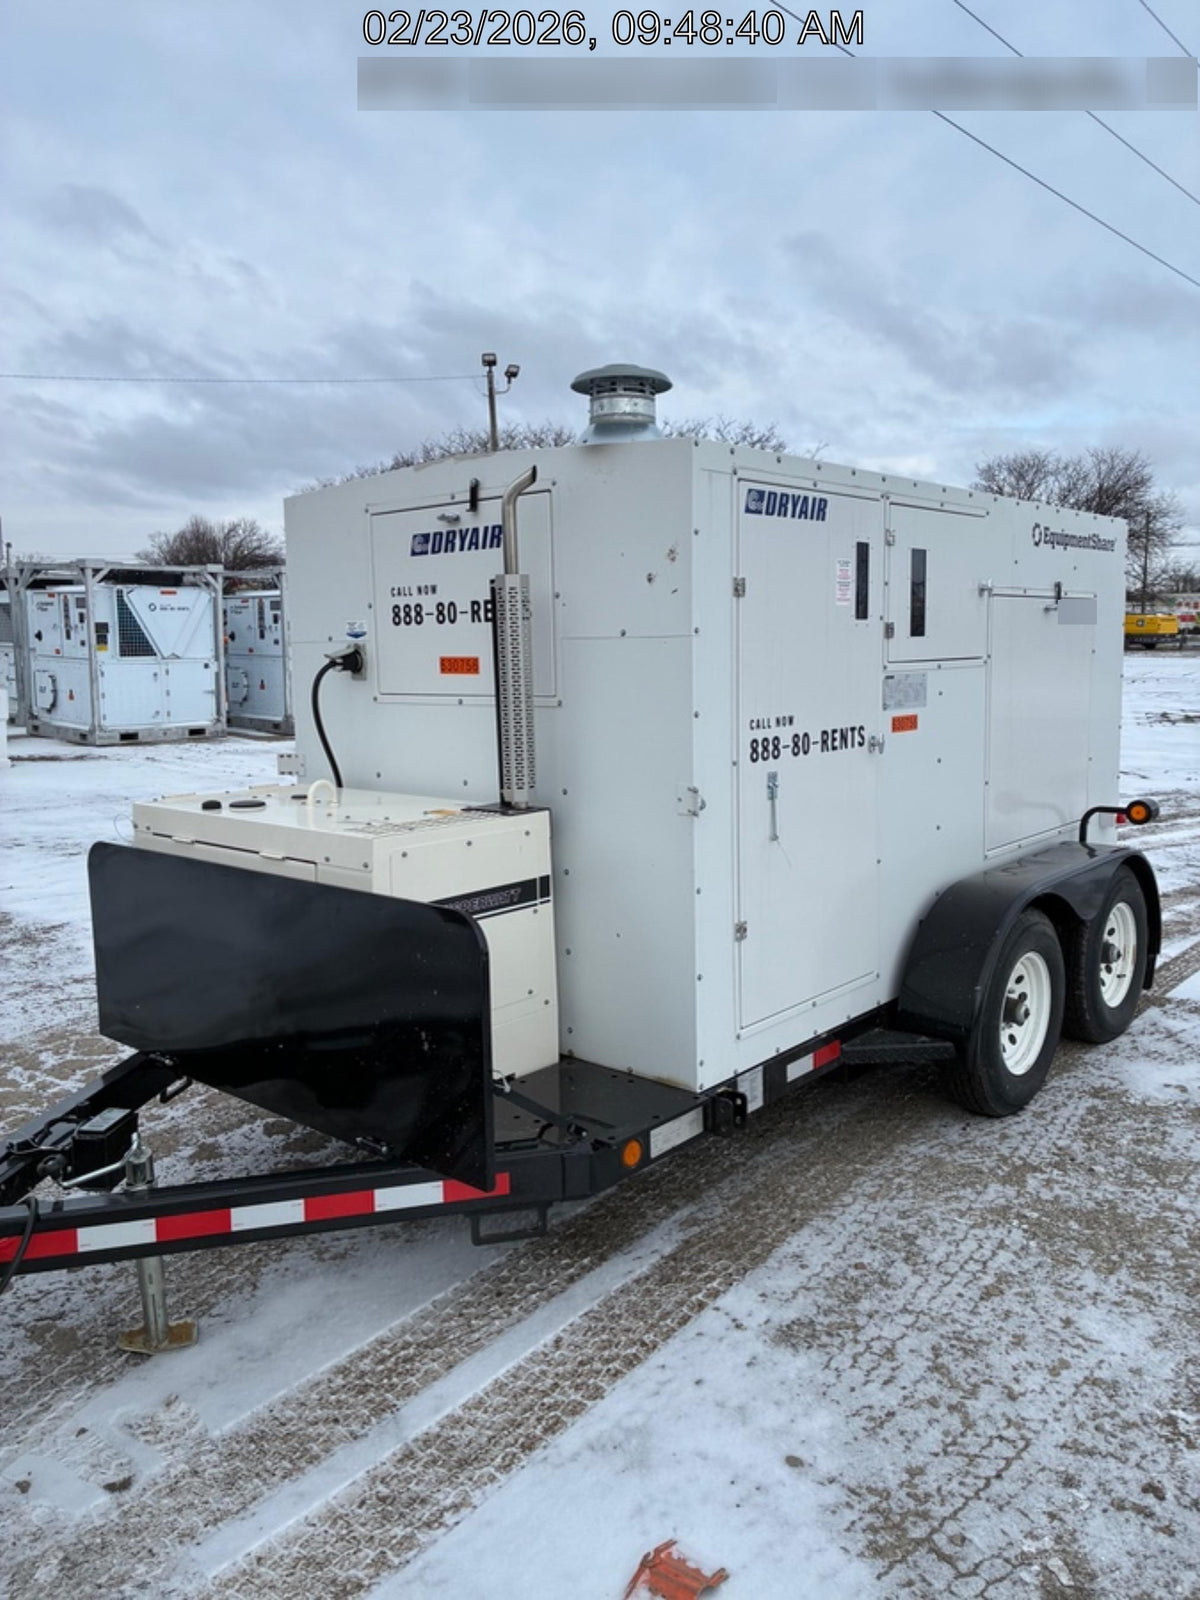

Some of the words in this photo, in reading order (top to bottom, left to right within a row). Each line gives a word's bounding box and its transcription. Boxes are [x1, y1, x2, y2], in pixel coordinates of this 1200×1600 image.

[765, 491, 828, 522] DRYAIR
[430, 524, 503, 555] DRYAIR
[1043, 525, 1116, 552] EquipmentShare
[390, 586, 413, 598] CALL
[416, 584, 437, 596] NOW
[391, 599, 493, 627] 888-80-RE
[749, 718, 771, 731] CALL
[775, 715, 794, 728] NOW
[749, 724, 866, 764] 888-80-RENTS
